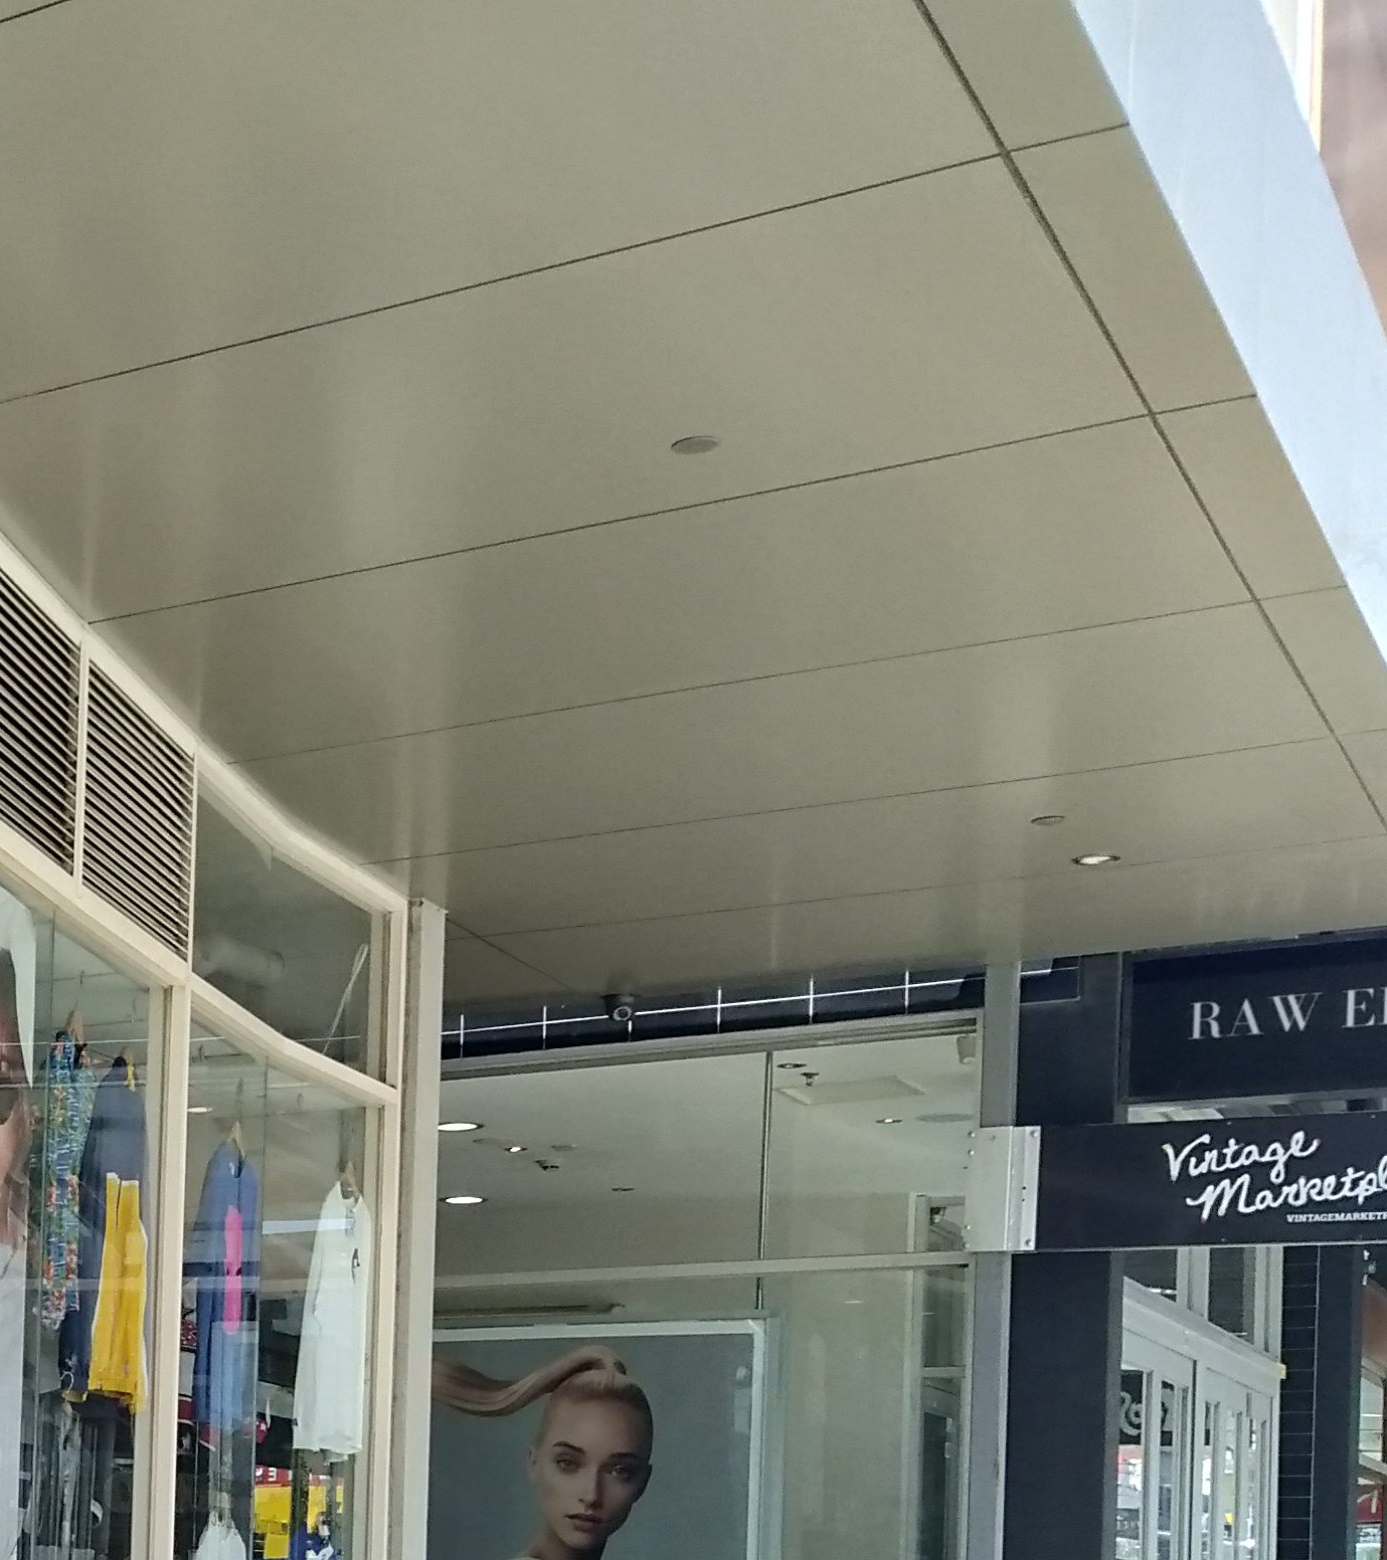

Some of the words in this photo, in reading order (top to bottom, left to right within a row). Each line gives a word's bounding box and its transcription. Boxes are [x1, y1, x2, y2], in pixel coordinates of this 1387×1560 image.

[1188, 992, 1325, 1041] RAW
[1341, 986, 1387, 1029] E
[1161, 1130, 1322, 1185] Vintage
